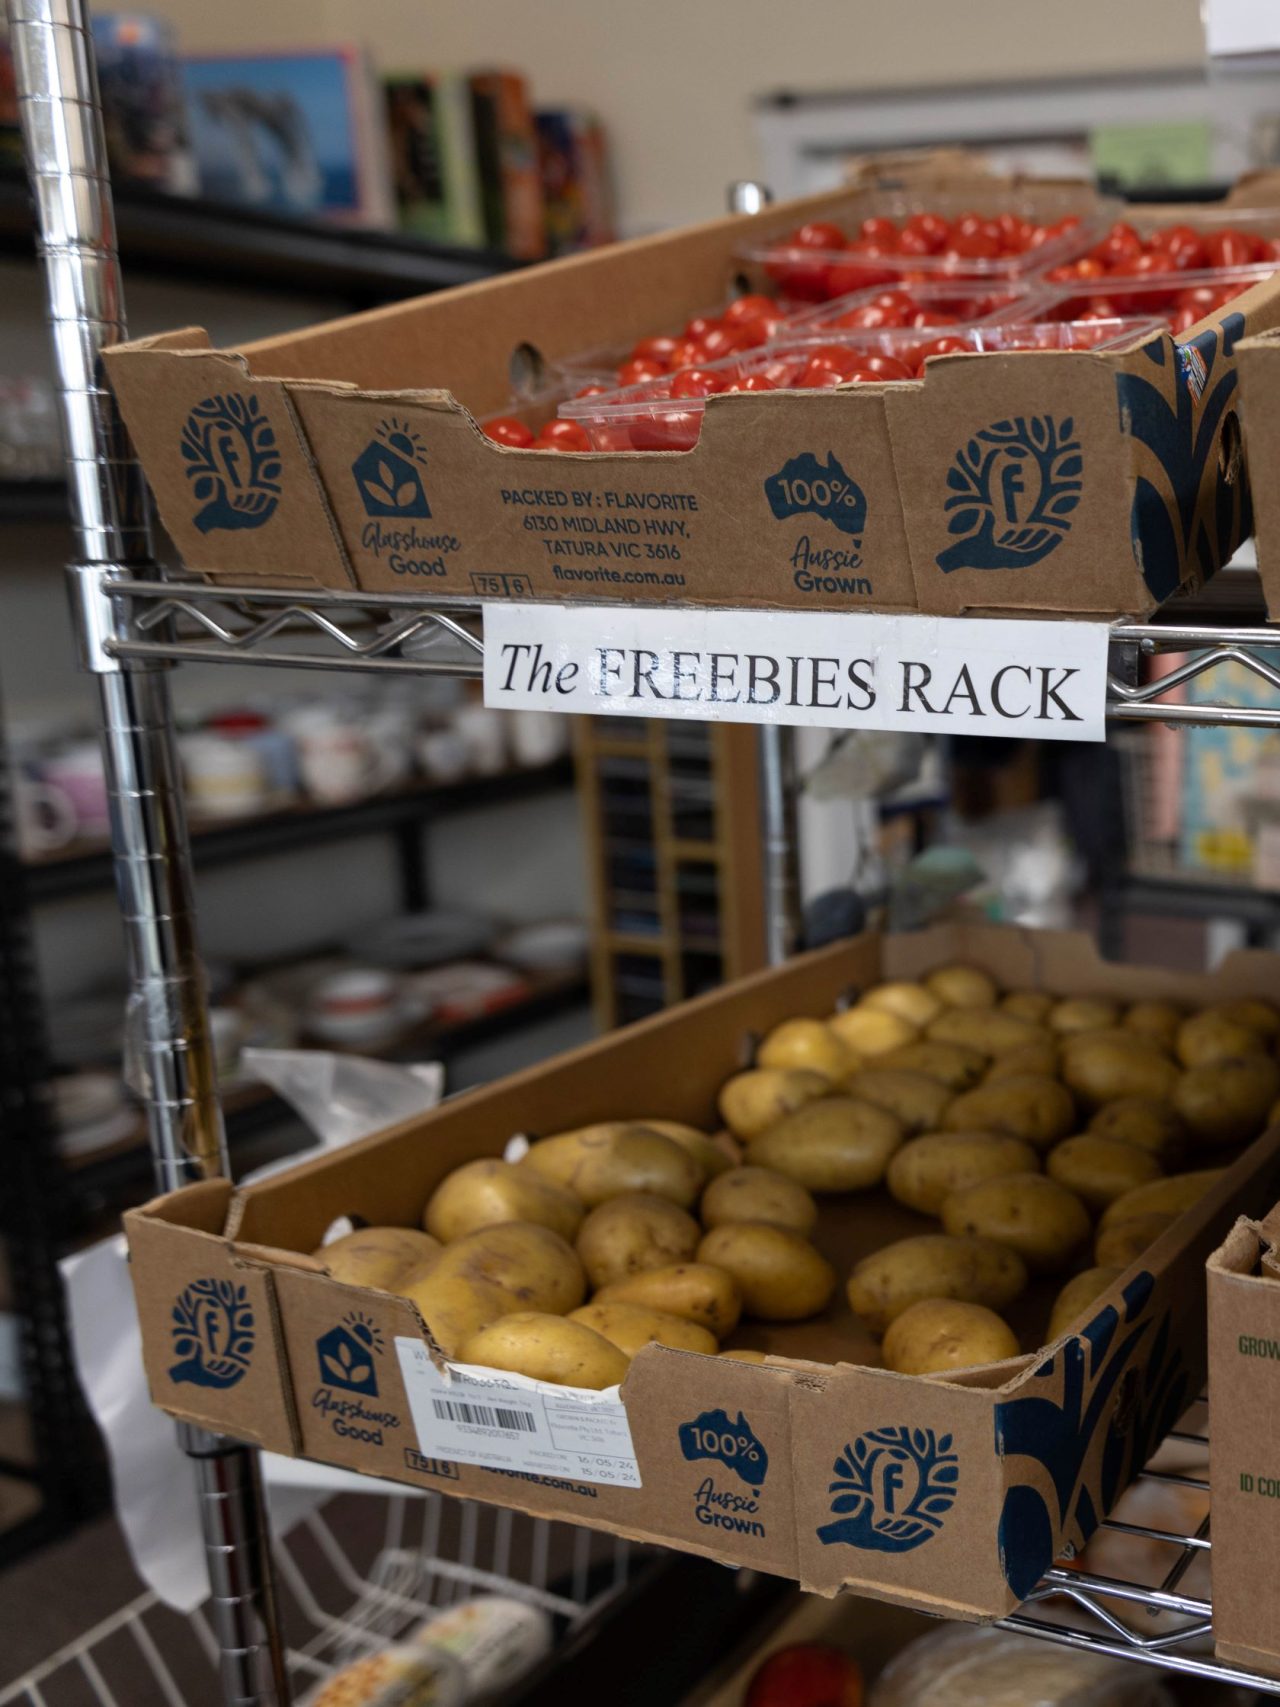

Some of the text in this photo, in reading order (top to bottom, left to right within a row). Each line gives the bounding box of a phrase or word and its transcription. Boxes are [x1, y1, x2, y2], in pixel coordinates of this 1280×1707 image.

[500, 488, 569, 508] PACKED
[603, 491, 699, 512] FLAVORITE
[777, 478, 857, 509] 100%
[361, 522, 462, 558] Glasshouse
[523, 515, 692, 539] 6130 MIDLAND HWY,
[543, 539, 681, 561] TATURA VIC 3616
[789, 535, 865, 571] Aussie
[388, 555, 448, 578] Good
[551, 565, 687, 587] flavorite.com.au
[477, 577, 525, 594] 75 6
[793, 570, 874, 595] Grown
[498, 643, 1085, 723] The FREEBIES RACK
[311, 1387, 401, 1430] Glasshouse
[332, 1417, 385, 1447] Good
[689, 1427, 760, 1463] 100%
[409, 1453, 428, 1470] 75
[692, 1476, 761, 1515] Aussie
[1239, 1472, 1254, 1493] ID
[694, 1504, 767, 1539] Grown
